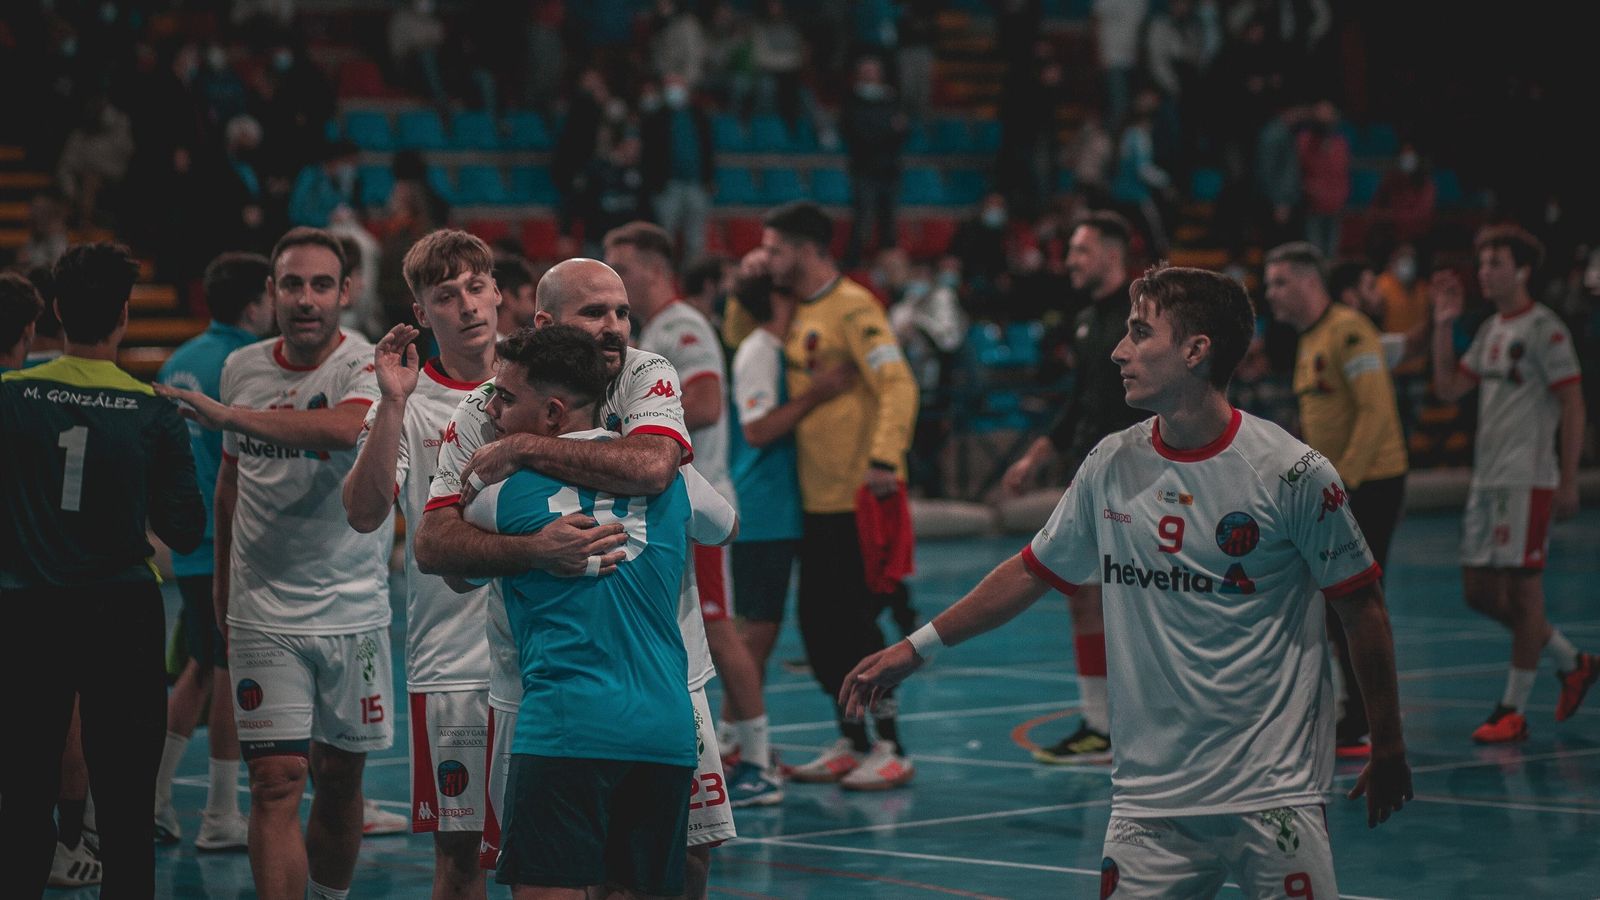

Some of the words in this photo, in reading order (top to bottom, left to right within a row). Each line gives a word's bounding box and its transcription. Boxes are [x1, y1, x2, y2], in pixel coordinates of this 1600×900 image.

[23, 386, 41, 400] M.
[46, 389, 140, 410] GONZÁLEZ
[58, 425, 89, 512] 1
[1158, 515, 1185, 554] 9
[360, 694, 384, 725] 15
[438, 807, 474, 818] Kappa
